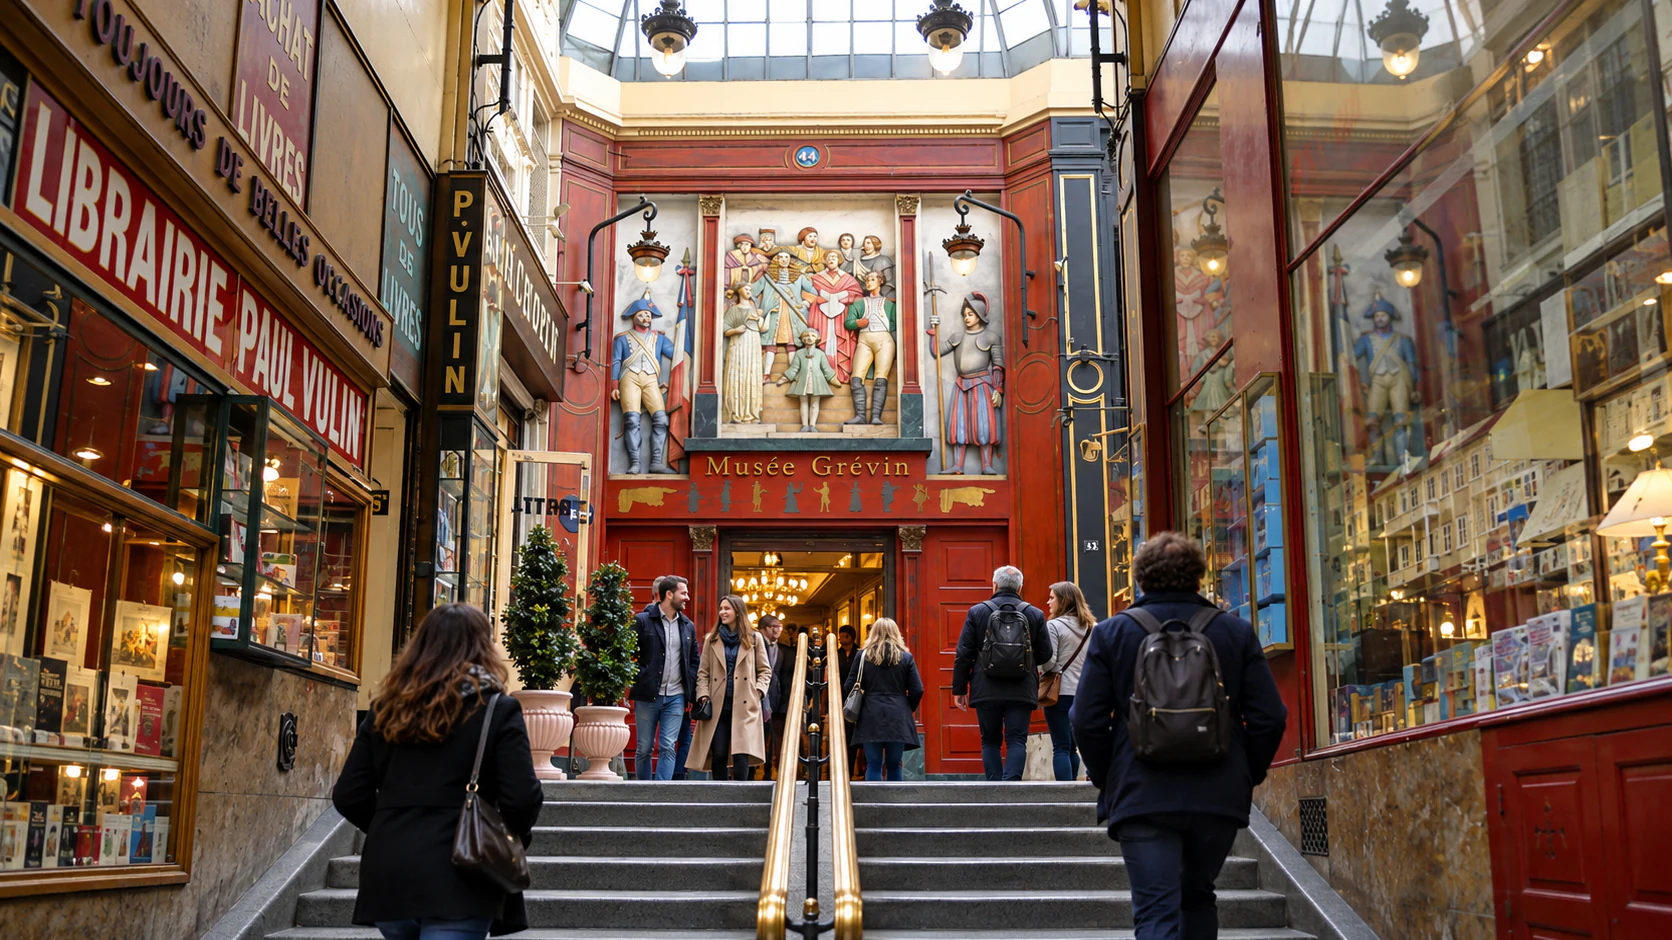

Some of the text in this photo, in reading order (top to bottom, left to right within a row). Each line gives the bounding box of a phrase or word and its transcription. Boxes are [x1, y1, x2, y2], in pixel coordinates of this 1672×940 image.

[267, 55, 290, 111] DE
[238, 79, 304, 207] LIVRES
[215, 137, 244, 193] DE
[249, 175, 309, 267] BELLES
[313, 252, 383, 348] OCCASIONS
[391, 167, 424, 248] TOUS
[25, 101, 362, 460] LIBRAIRIE PAUL VULIN
[383, 266, 422, 351] LIVRES
[705, 456, 910, 477] Musée Grévin
